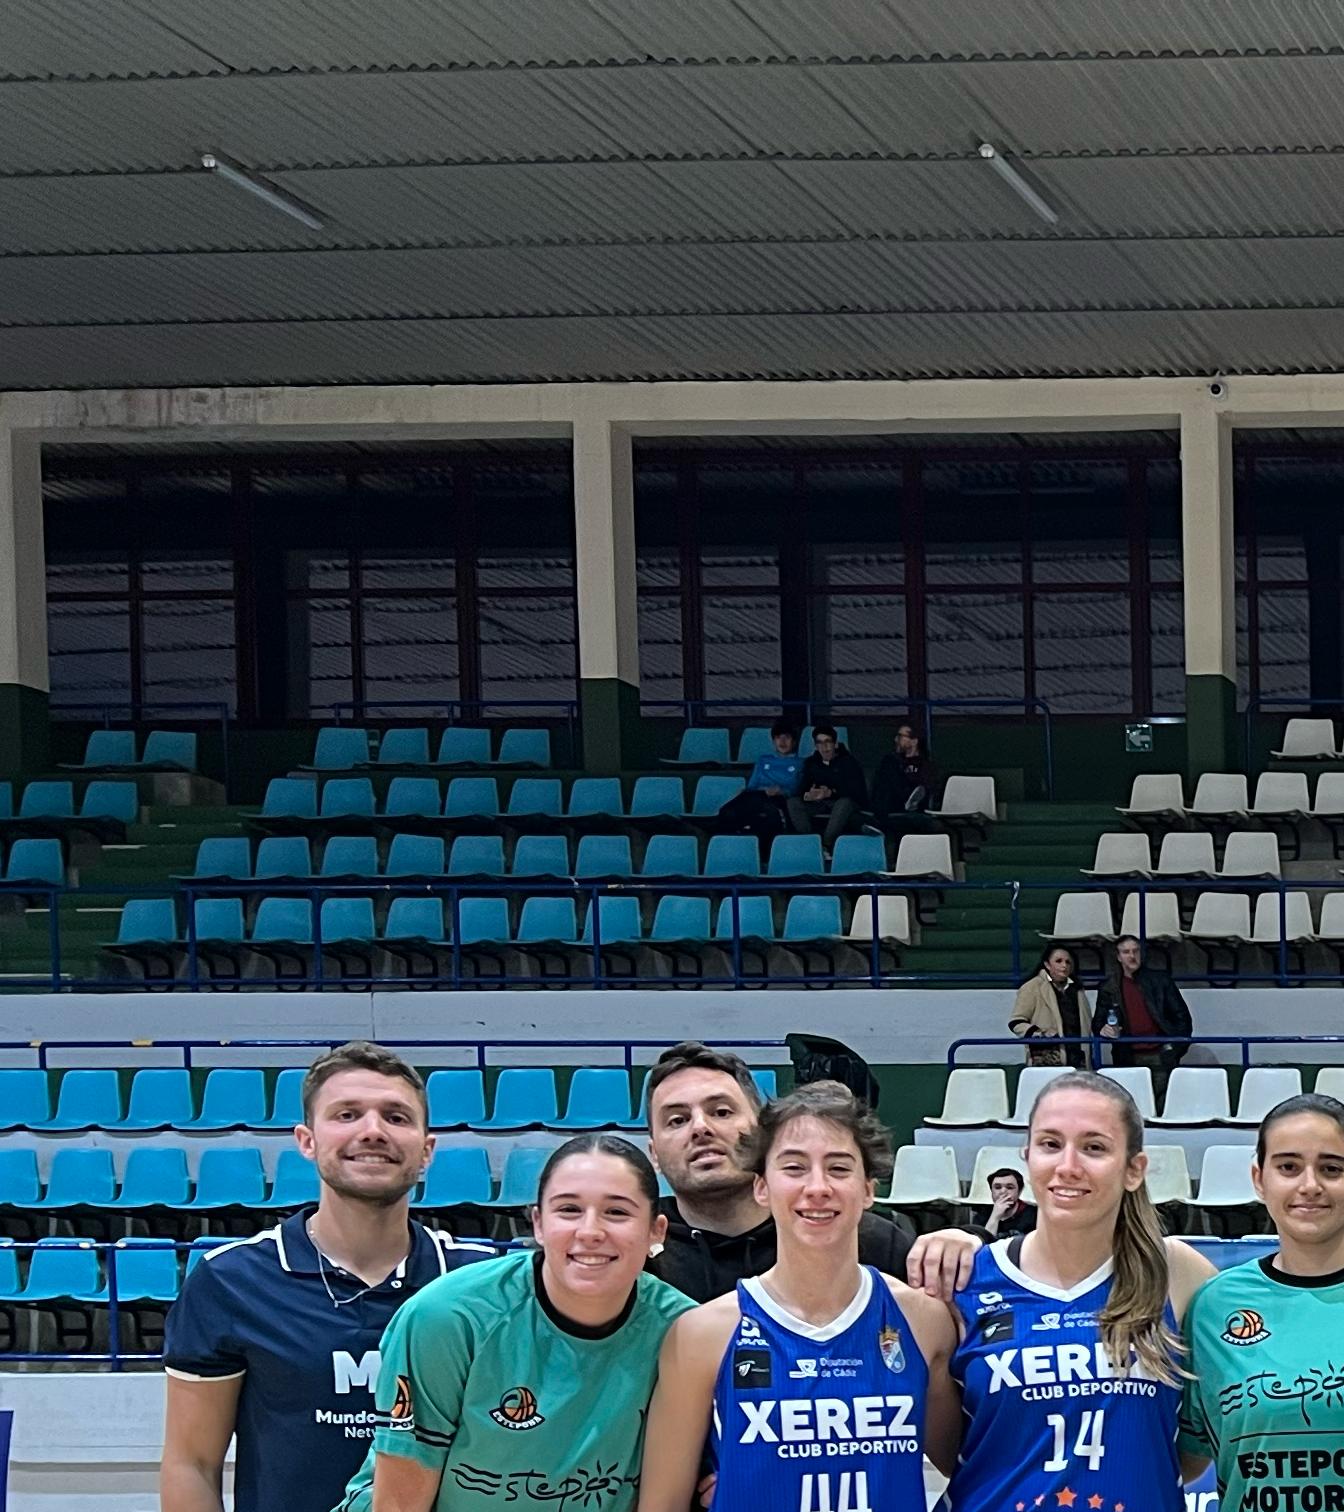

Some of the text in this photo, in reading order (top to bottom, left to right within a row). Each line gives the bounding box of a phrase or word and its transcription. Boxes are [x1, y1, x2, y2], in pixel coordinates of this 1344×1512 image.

[1021, 1381, 1157, 1401] CLUB DEPORTIVO
[739, 1395, 917, 1443] XEREZ
[777, 1439, 918, 1459] CLUB DEPORTIVO
[1043, 1409, 1105, 1472] 14
